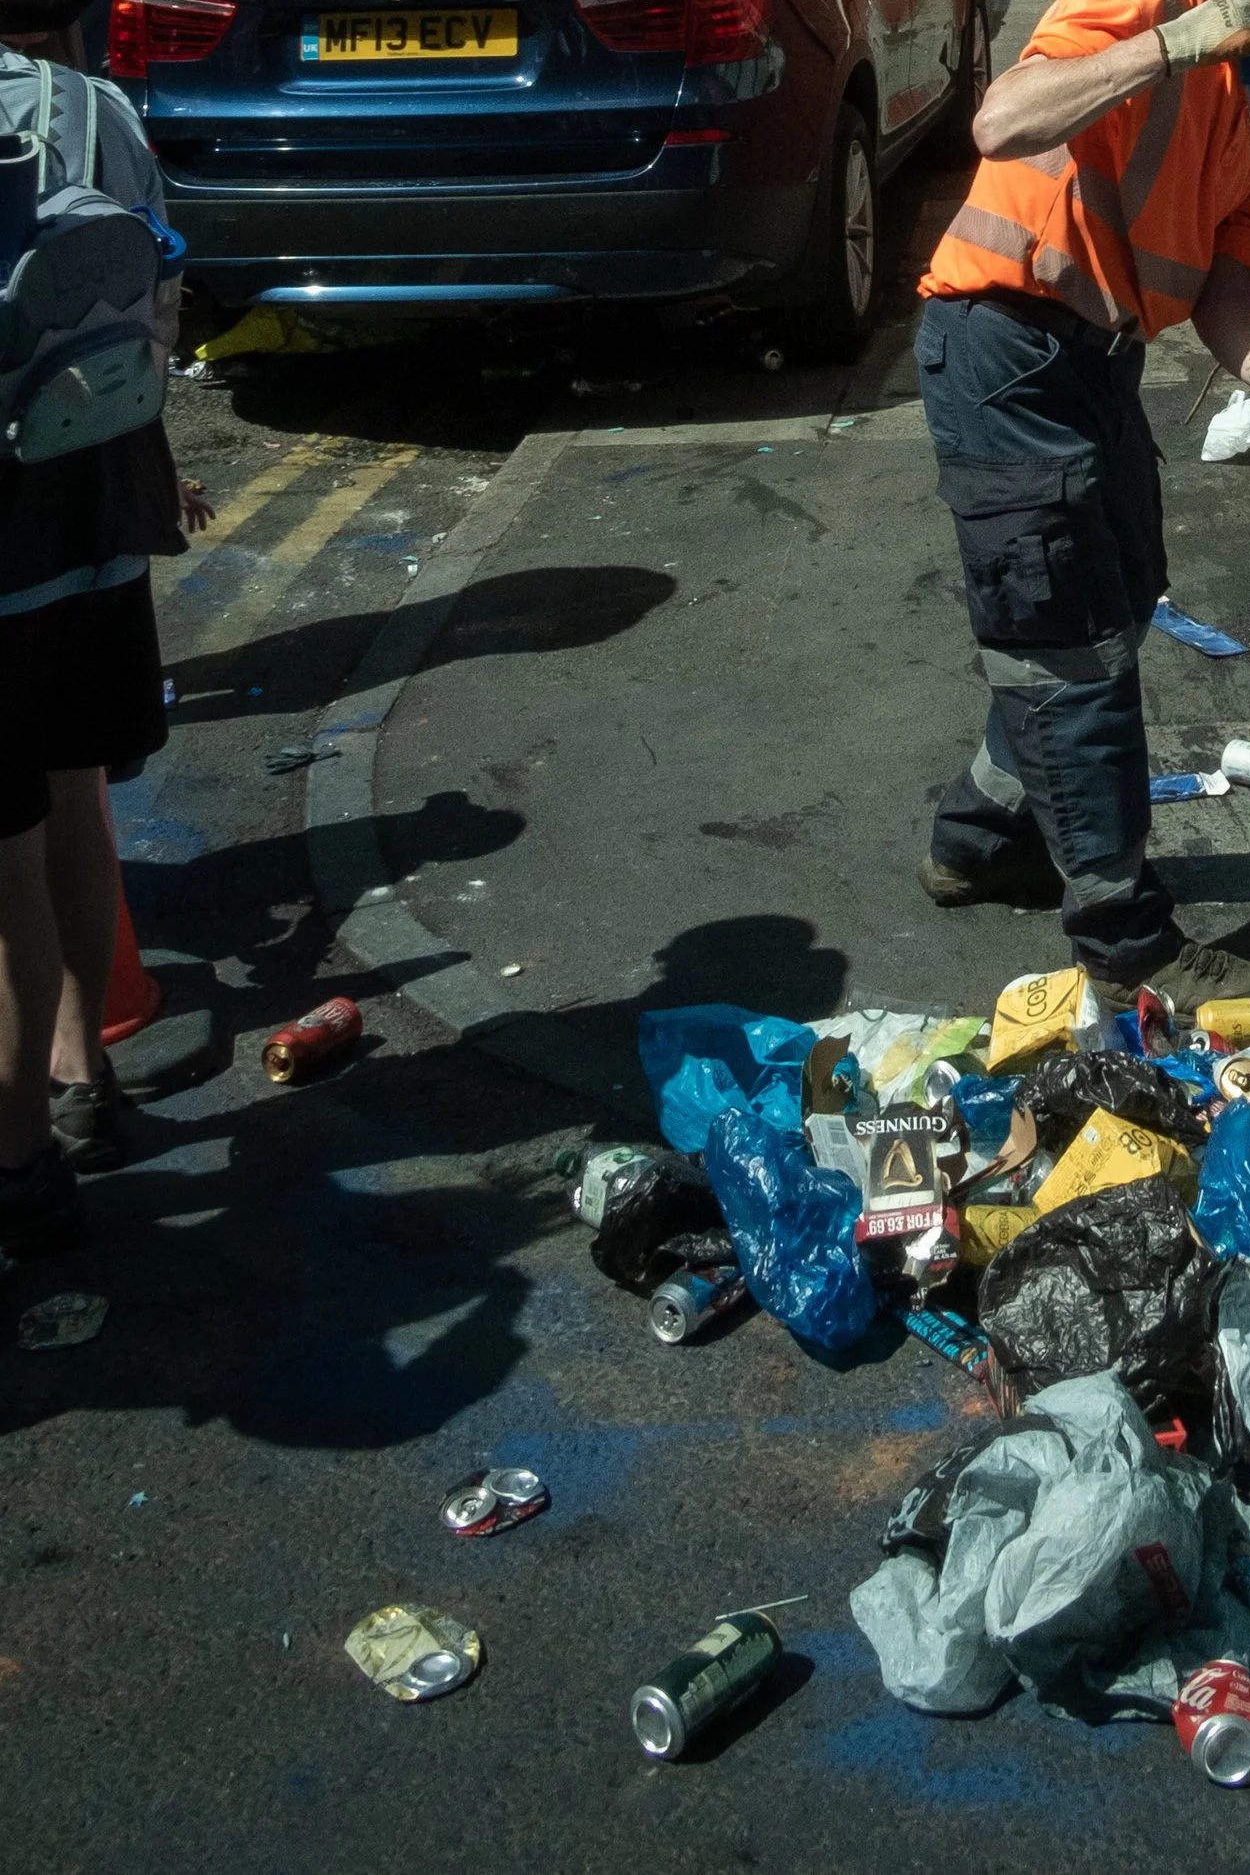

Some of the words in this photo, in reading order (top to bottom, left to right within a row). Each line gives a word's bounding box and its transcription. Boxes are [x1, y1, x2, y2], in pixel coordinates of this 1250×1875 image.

[303, 43, 318, 53] UK
[325, 17, 409, 53] MF13
[1027, 976, 1047, 1018] COB
[856, 1115, 947, 1136] GUINNESS
[905, 1214, 932, 1231] FOR
[998, 1211, 1010, 1247] COBRA
